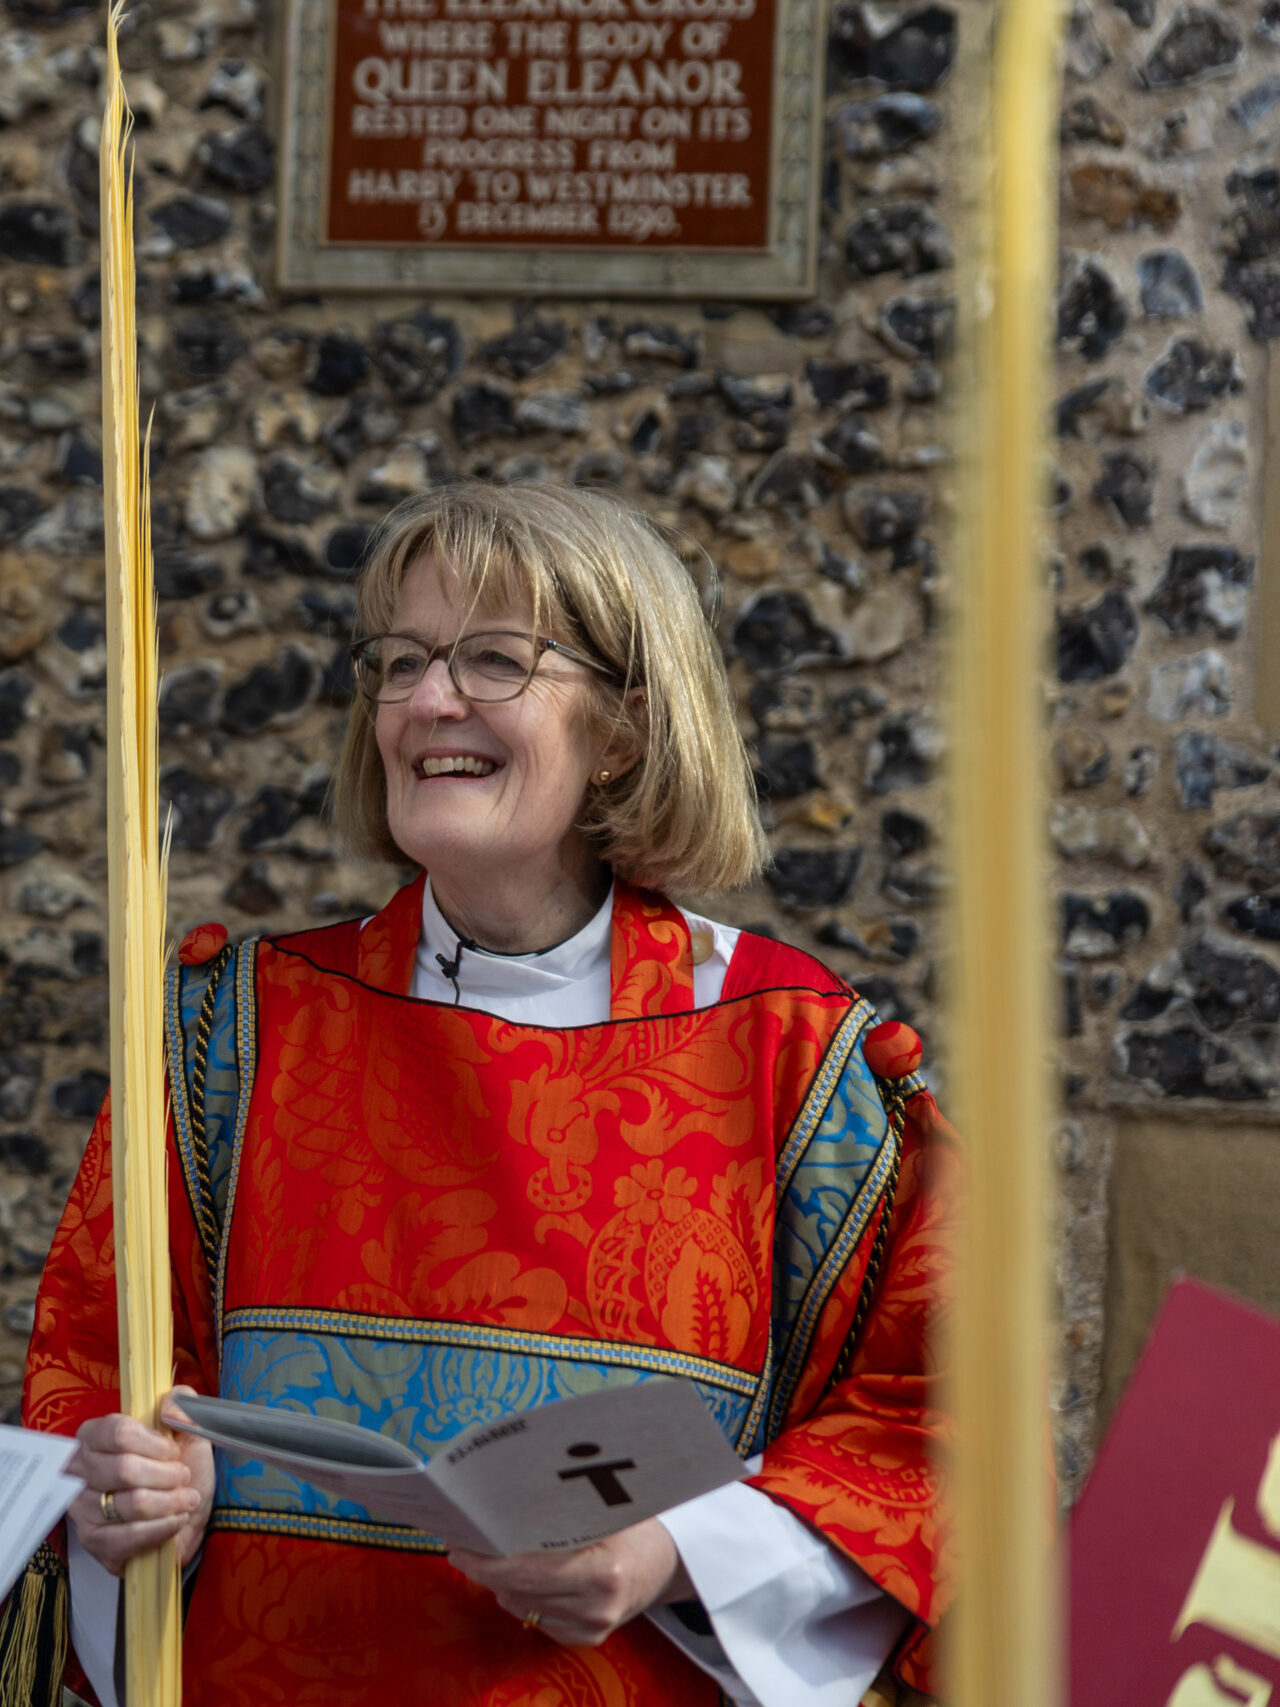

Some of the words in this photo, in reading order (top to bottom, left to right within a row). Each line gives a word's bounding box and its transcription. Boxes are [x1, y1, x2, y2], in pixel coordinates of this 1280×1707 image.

[379, 20, 495, 54] WHERE
[503, 21, 569, 56] THE
[577, 21, 673, 57] BODY
[681, 22, 731, 56] OF
[352, 57, 508, 106] QUEEN
[527, 59, 745, 105] ELEANOR
[352, 105, 468, 138] RESTED
[472, 106, 539, 138] ONE
[544, 107, 637, 138] NIGHT
[640, 107, 692, 140] ON
[699, 108, 751, 141] ITS
[423, 138, 576, 169] PROGRESS
[588, 139, 676, 170] FROM
[347, 169, 461, 204] HARBY
[473, 170, 520, 204] TO
[526, 171, 753, 208] WESTMINSTER
[456, 203, 599, 234] DECEMBER
